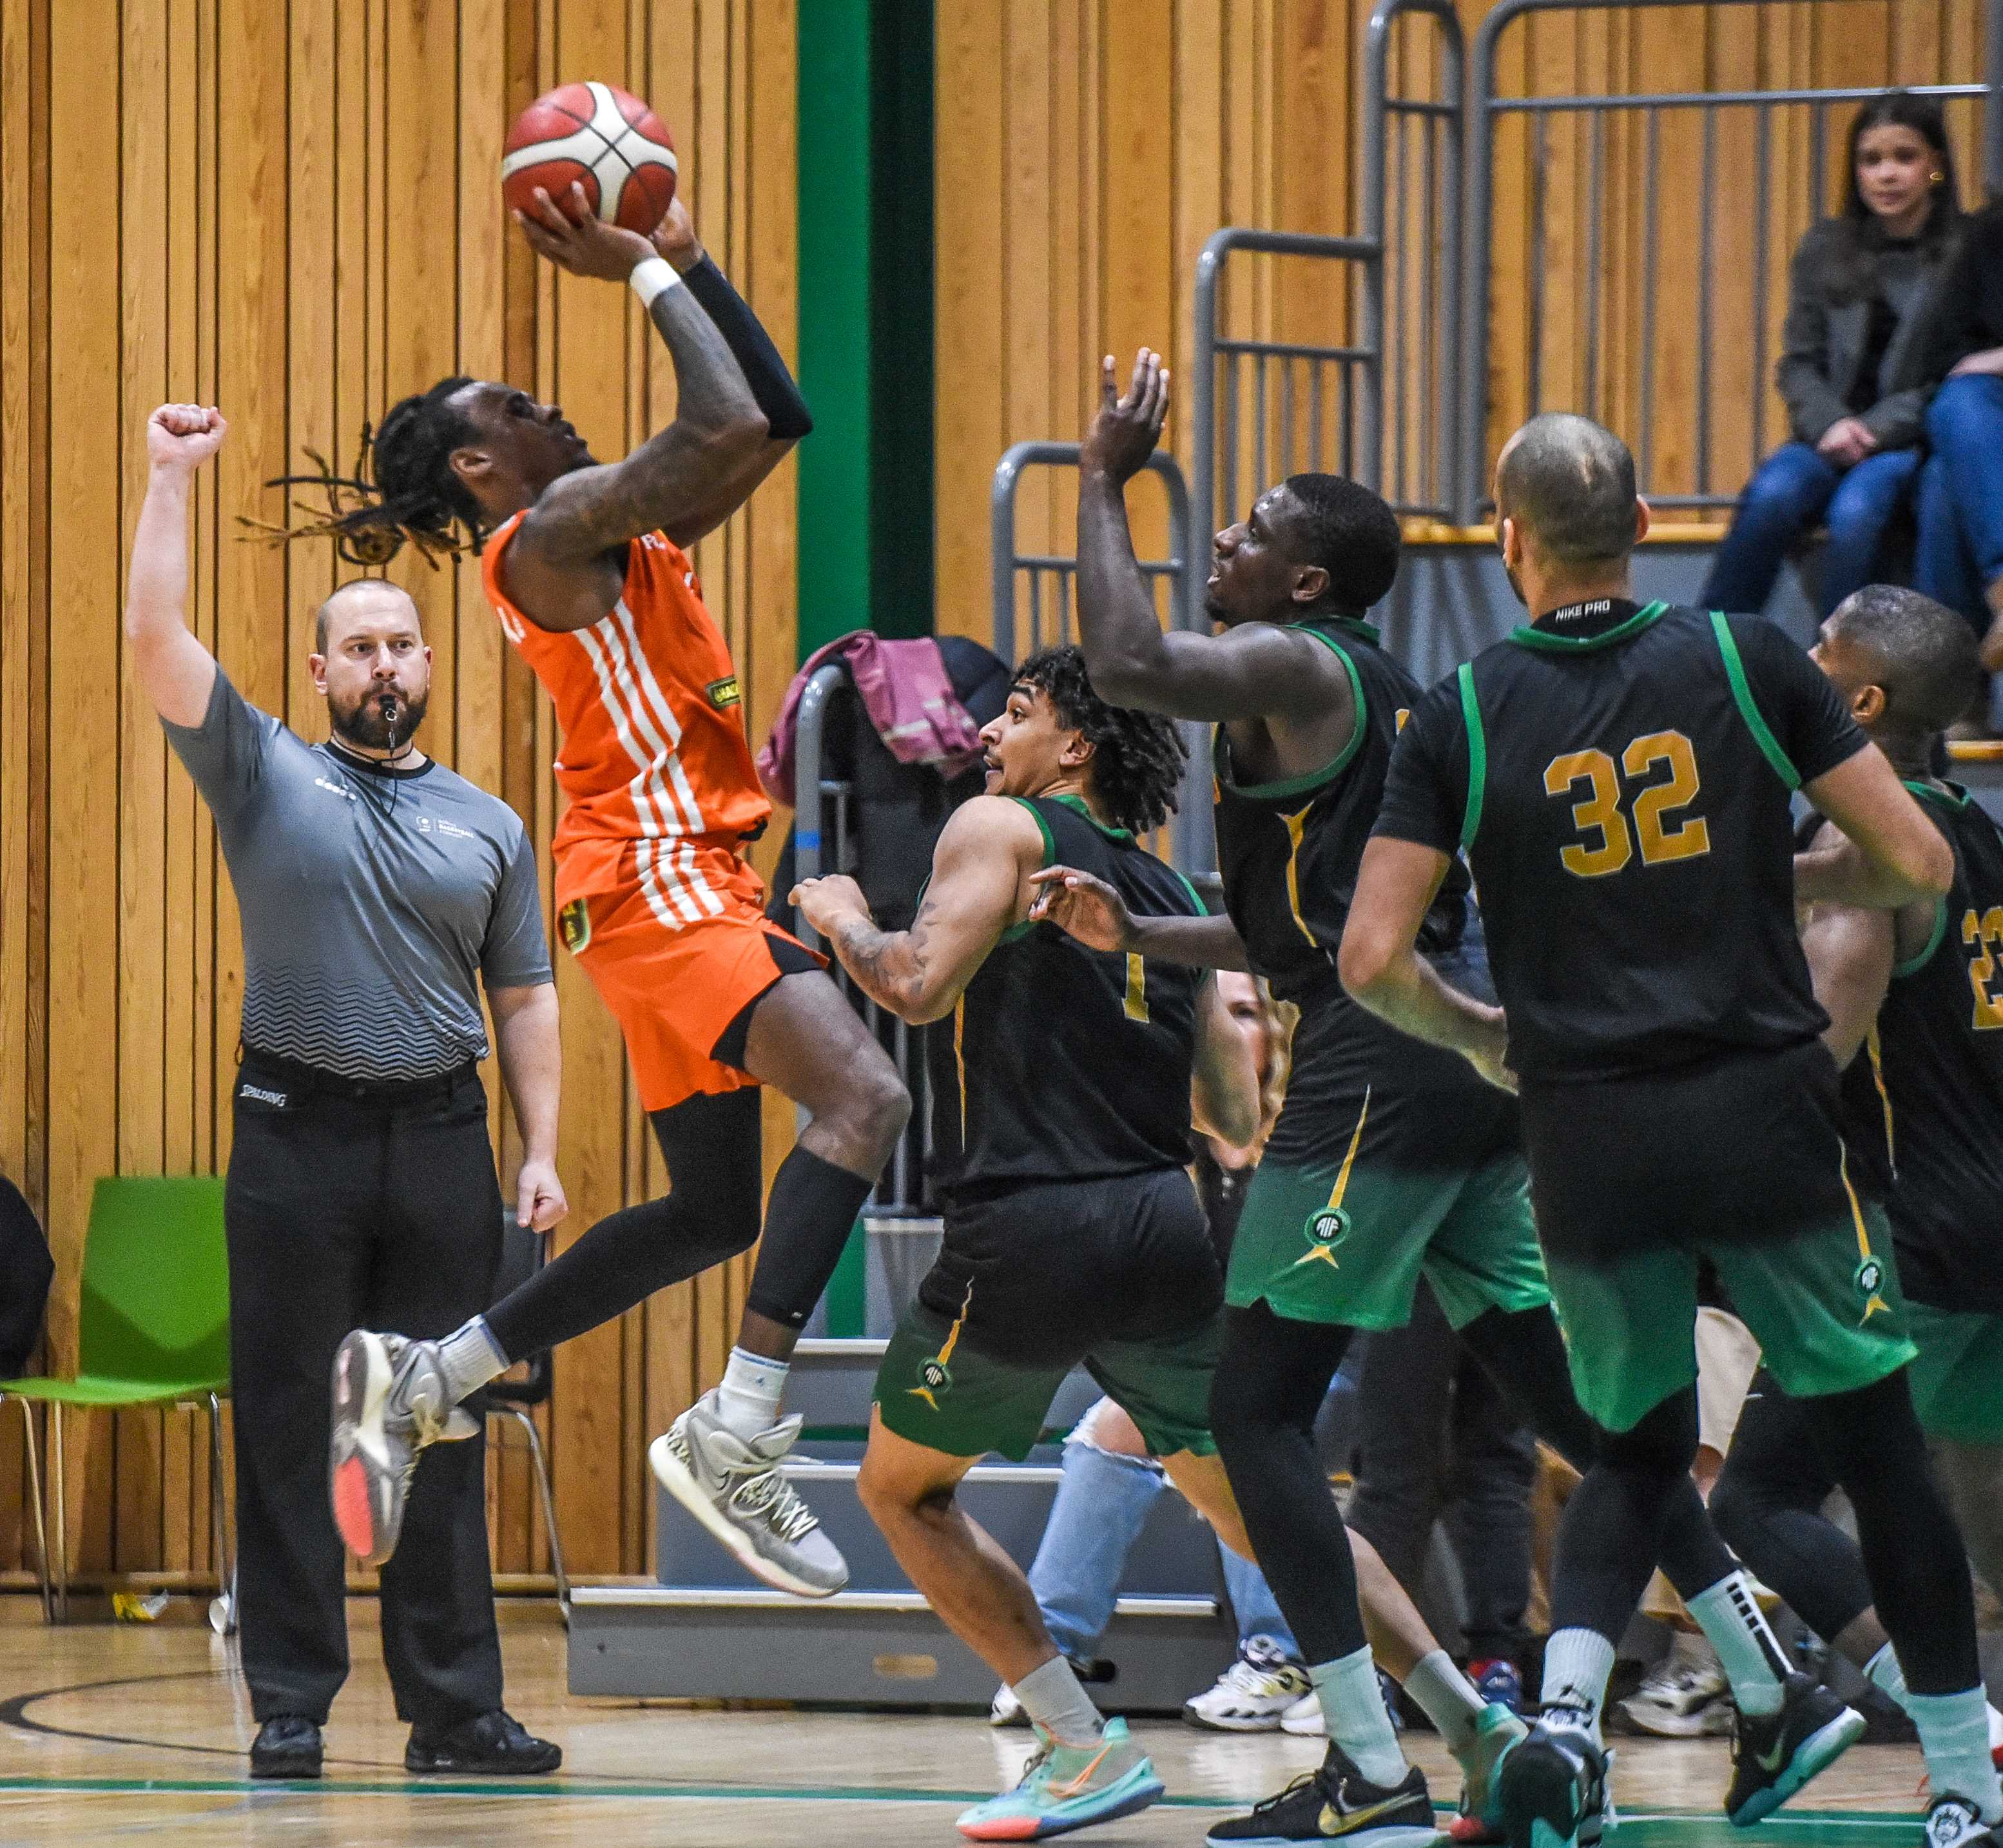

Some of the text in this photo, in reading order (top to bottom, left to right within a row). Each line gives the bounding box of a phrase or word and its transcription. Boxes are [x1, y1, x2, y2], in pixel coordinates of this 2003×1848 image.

[1556, 599, 1611, 623] NIKE PRO
[1543, 729, 1710, 877] 32
[1316, 1216, 1340, 1238] AIF
